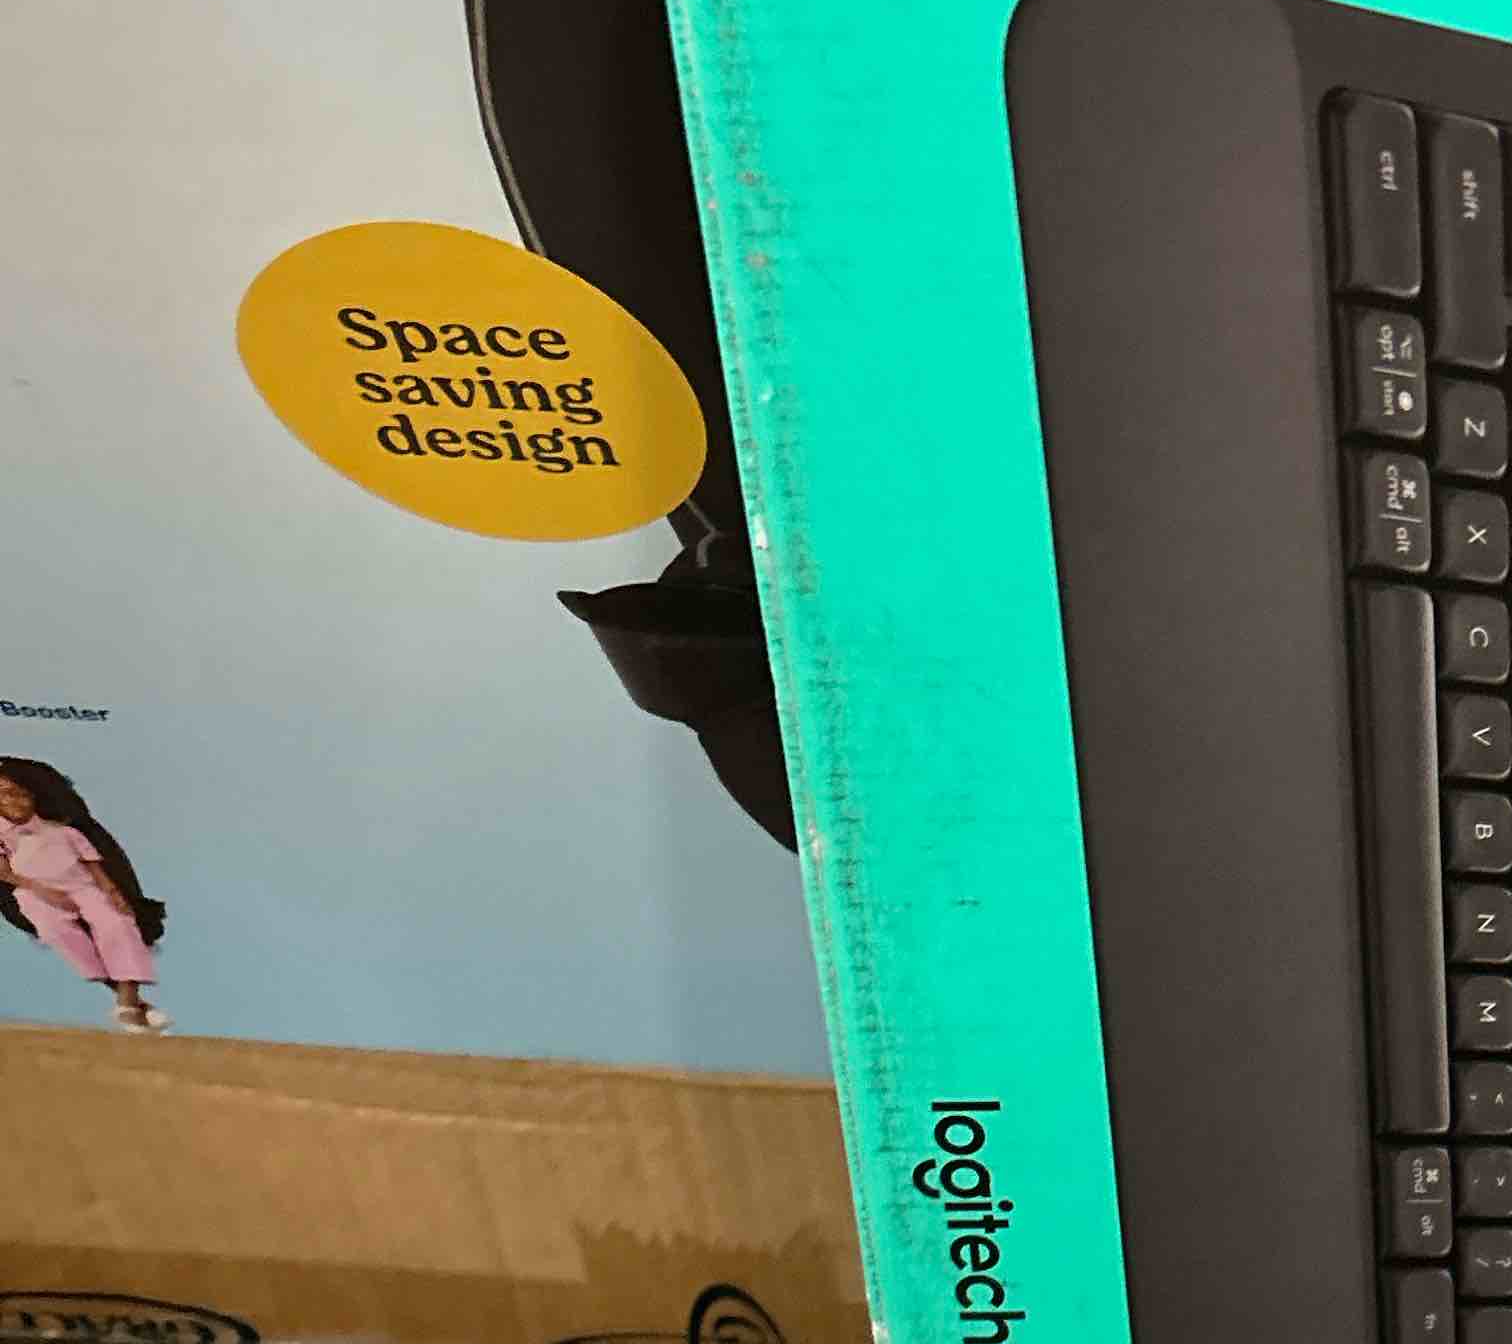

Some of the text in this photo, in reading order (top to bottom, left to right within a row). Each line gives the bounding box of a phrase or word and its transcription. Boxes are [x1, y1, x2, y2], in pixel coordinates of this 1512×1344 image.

[1376, 149, 1402, 193] ctrl
[1459, 167, 1483, 222] shift
[337, 306, 571, 363] Space
[1377, 323, 1397, 363] opt
[354, 366, 603, 426] saving
[1464, 417, 1488, 441] Z
[377, 413, 622, 475] design
[1386, 464, 1403, 512] cmd
[1393, 524, 1412, 556] alt
[1467, 523, 1489, 547] X
[1469, 625, 1491, 650] C
[0, 700, 112, 722] Booster
[1471, 724, 1493, 748] V
[1474, 821, 1495, 842] B
[1476, 911, 1497, 935] N
[1478, 999, 1498, 1024] M
